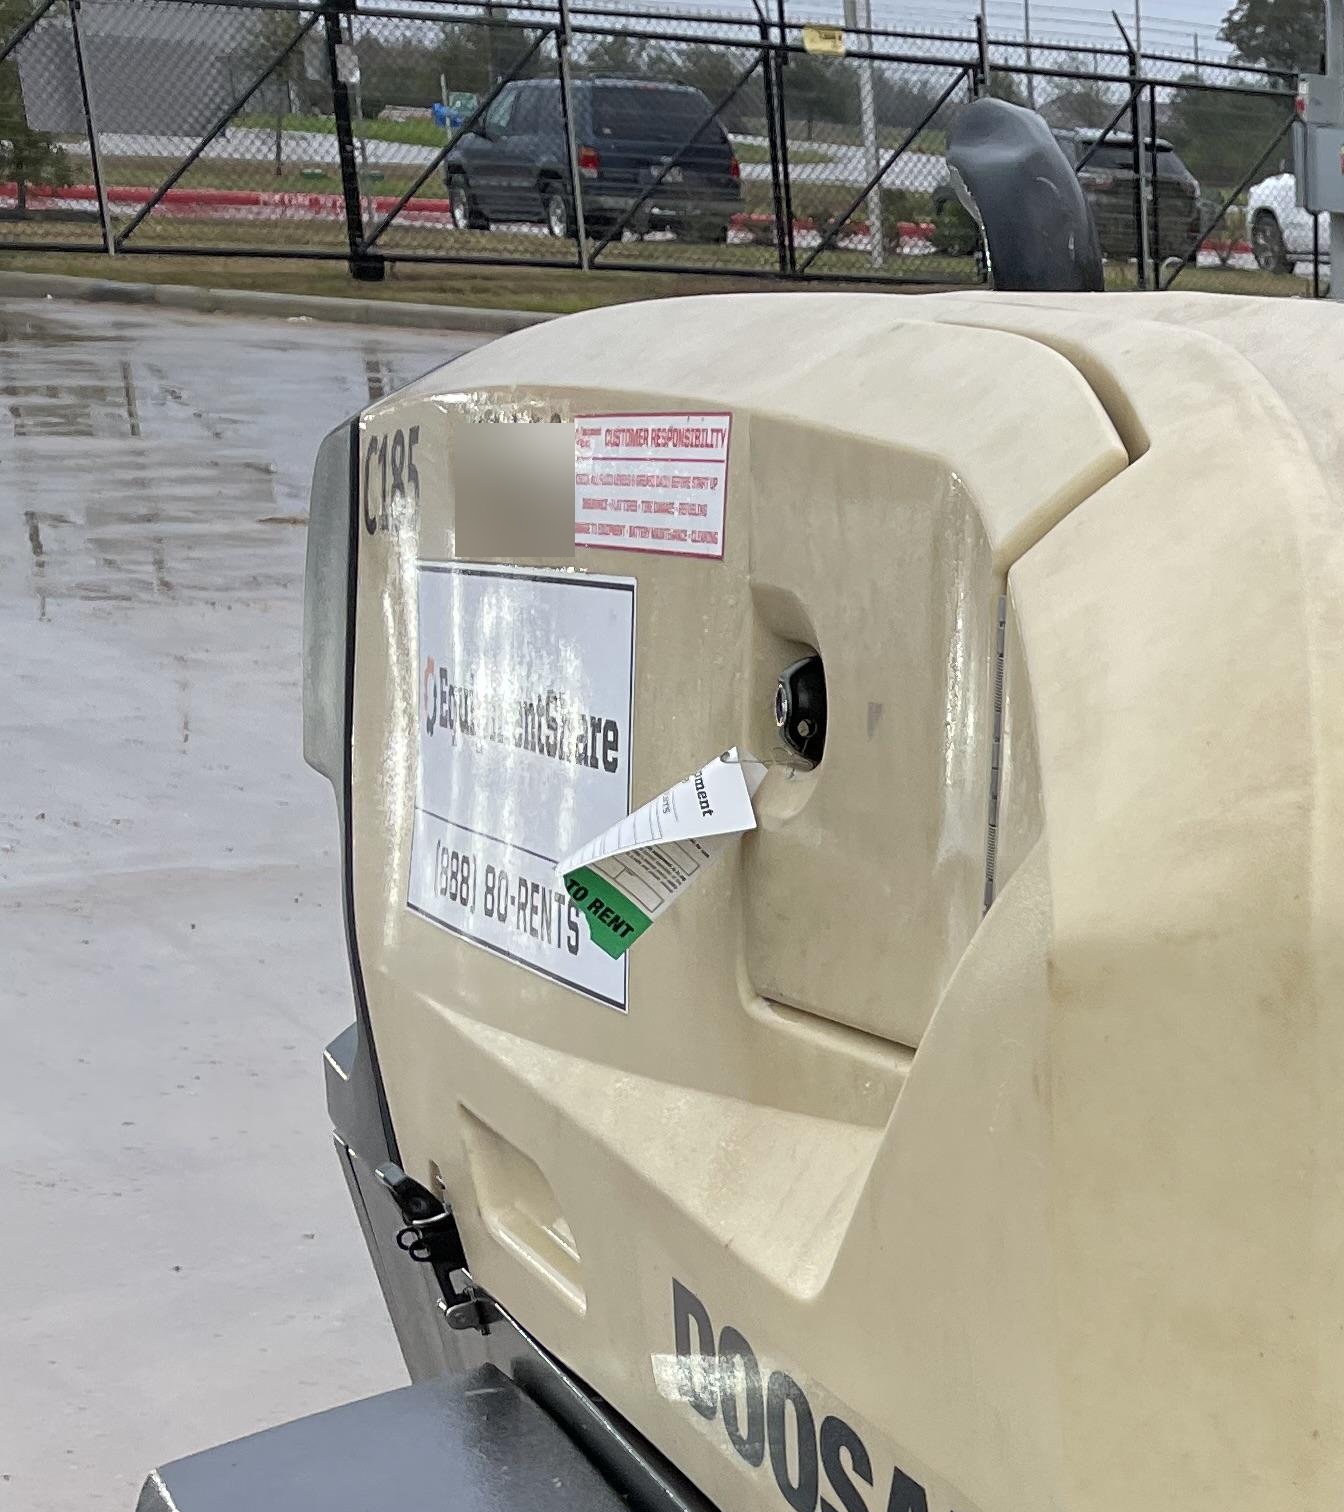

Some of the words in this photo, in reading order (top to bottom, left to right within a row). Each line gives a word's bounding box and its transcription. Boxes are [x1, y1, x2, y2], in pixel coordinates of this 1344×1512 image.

[364, 425, 420, 535] C185
[604, 428, 649, 447] CUSTOMER
[651, 427, 727, 448] RESPONSIBILITY
[434, 839, 479, 913] (888)
[484, 865, 580, 956] 80-RENTS
[567, 878, 589, 902] TO
[587, 897, 634, 938] RENT
